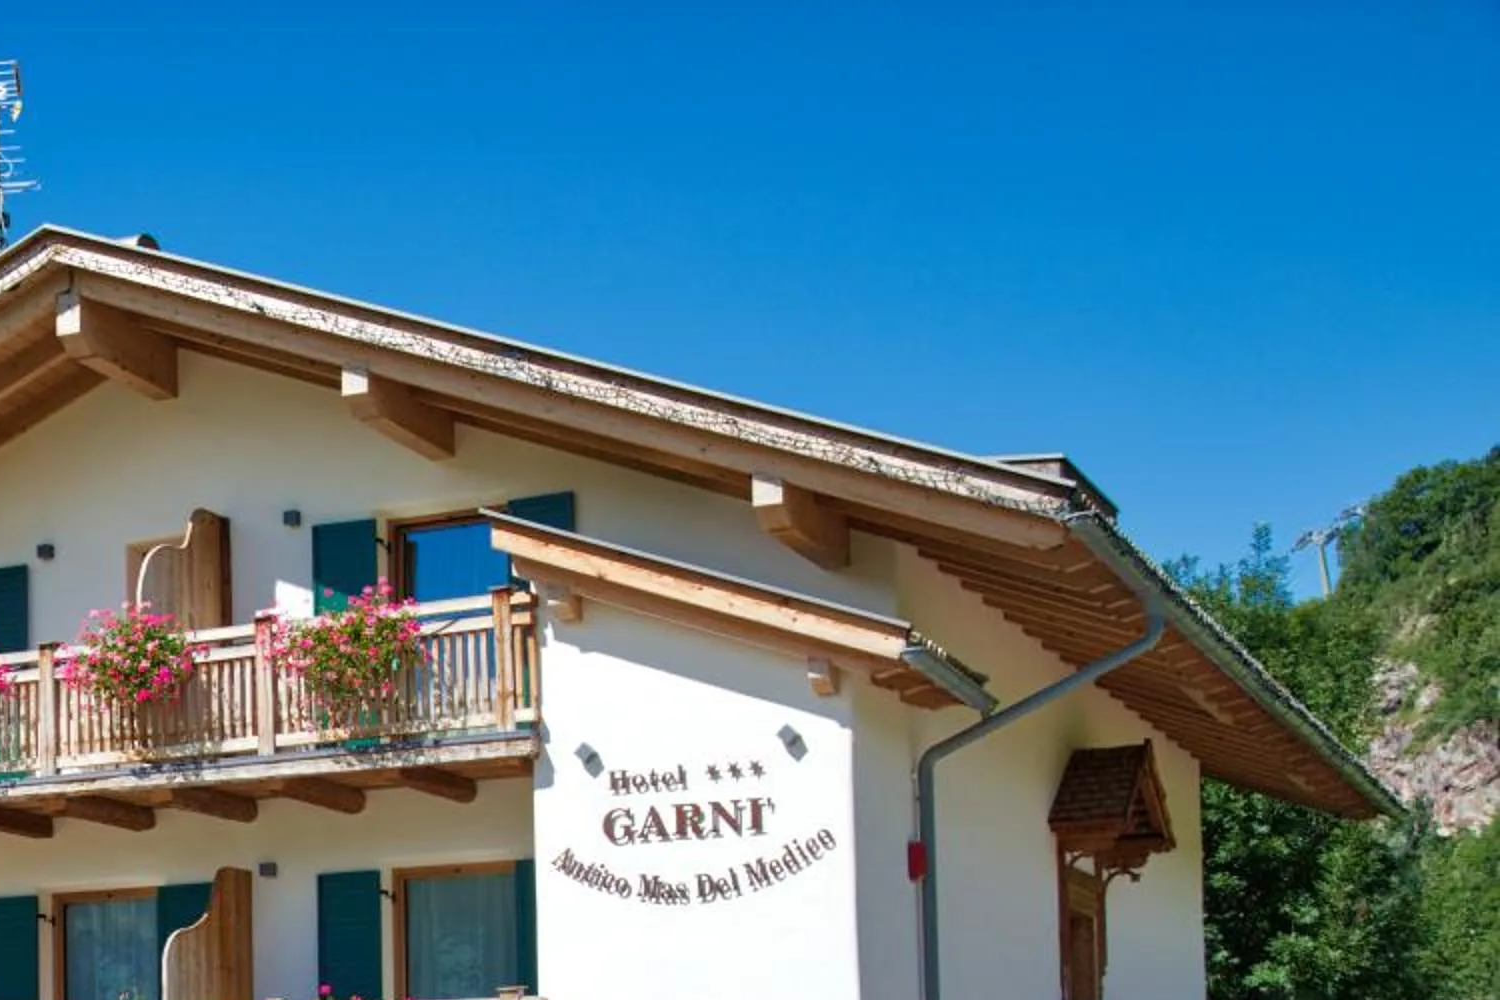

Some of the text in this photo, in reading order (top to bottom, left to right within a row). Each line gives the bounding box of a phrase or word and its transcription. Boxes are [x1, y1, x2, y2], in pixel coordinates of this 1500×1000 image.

[608, 764, 689, 796] Hotel
[551, 848, 632, 899] Antico
[637, 873, 691, 906] Mas
[695, 867, 743, 904] Del
